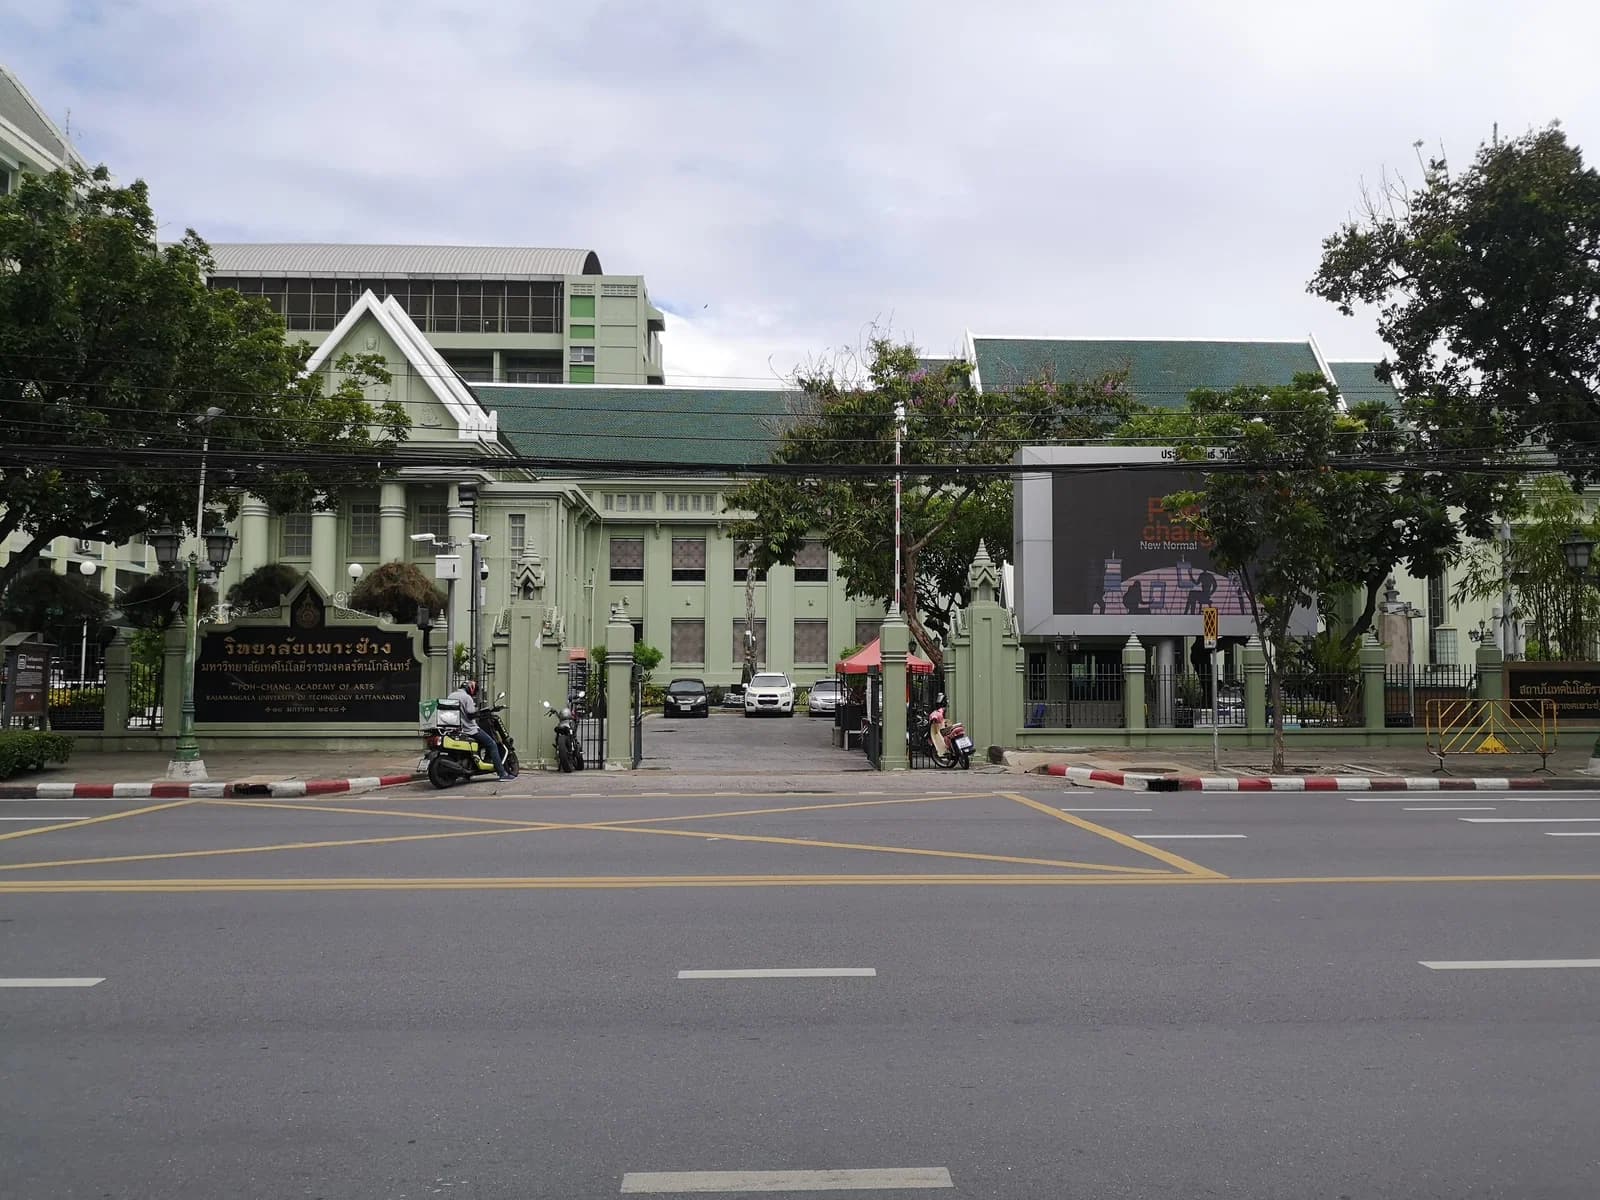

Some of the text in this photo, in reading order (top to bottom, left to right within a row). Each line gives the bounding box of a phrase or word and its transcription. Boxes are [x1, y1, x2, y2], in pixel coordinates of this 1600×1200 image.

[1140, 541, 1198, 550] New Normal
[295, 682, 336, 690] ACADEMY
[339, 682, 350, 690] OF
[353, 682, 375, 690] ARTS
